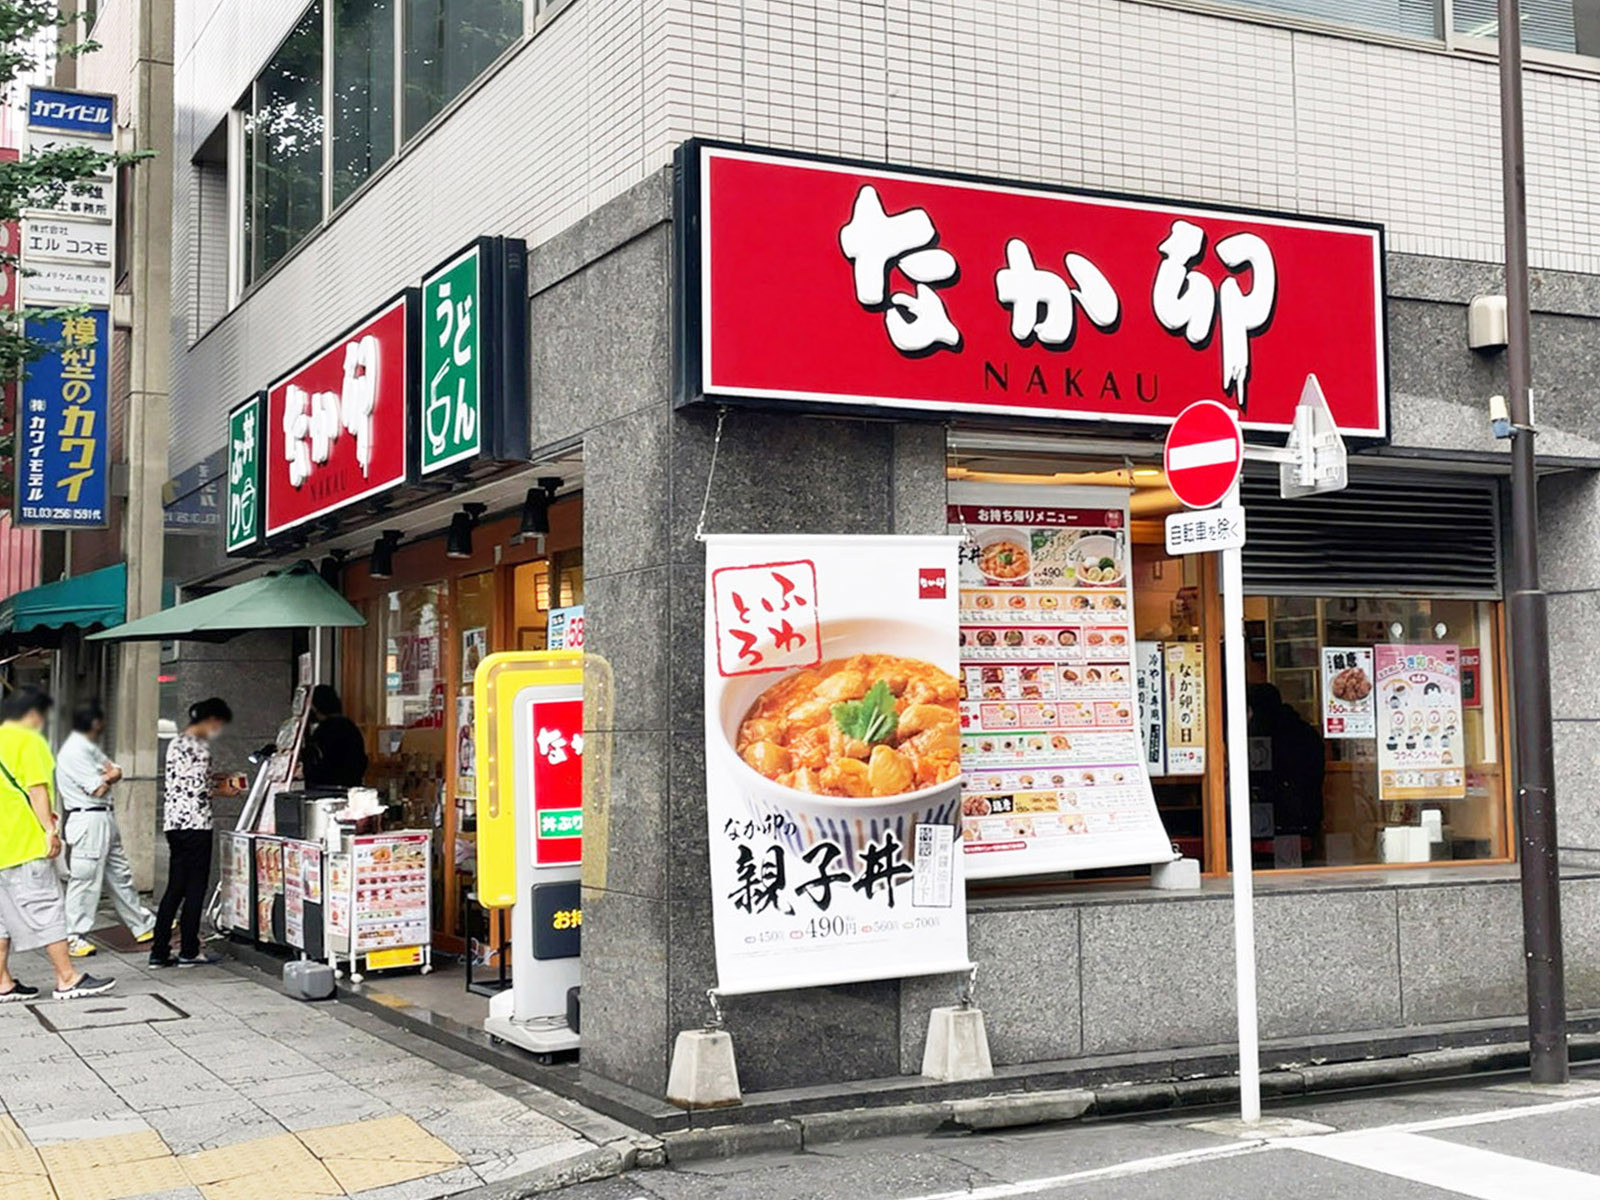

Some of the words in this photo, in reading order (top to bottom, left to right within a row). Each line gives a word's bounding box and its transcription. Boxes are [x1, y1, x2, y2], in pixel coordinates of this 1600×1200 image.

[32, 99, 110, 124] カワイビル
[30, 224, 69, 237] 株式会社
[30, 236, 60, 250] エル
[66, 239, 108, 255] コスモ
[838, 185, 1277, 412] なか卯
[434, 282, 477, 445] うどん
[983, 361, 1160, 402] NAKAU
[57, 315, 98, 503] 模型のカワイ
[283, 335, 378, 488] なか卯
[977, 508, 1079, 523] お持ち帰りメニュー
[1170, 518, 1239, 546] 自転車を除く
[728, 591, 764, 666] とろ
[761, 571, 808, 652] ふわ
[723, 812, 798, 841] なか卯の
[727, 833, 914, 917] 親子丼
